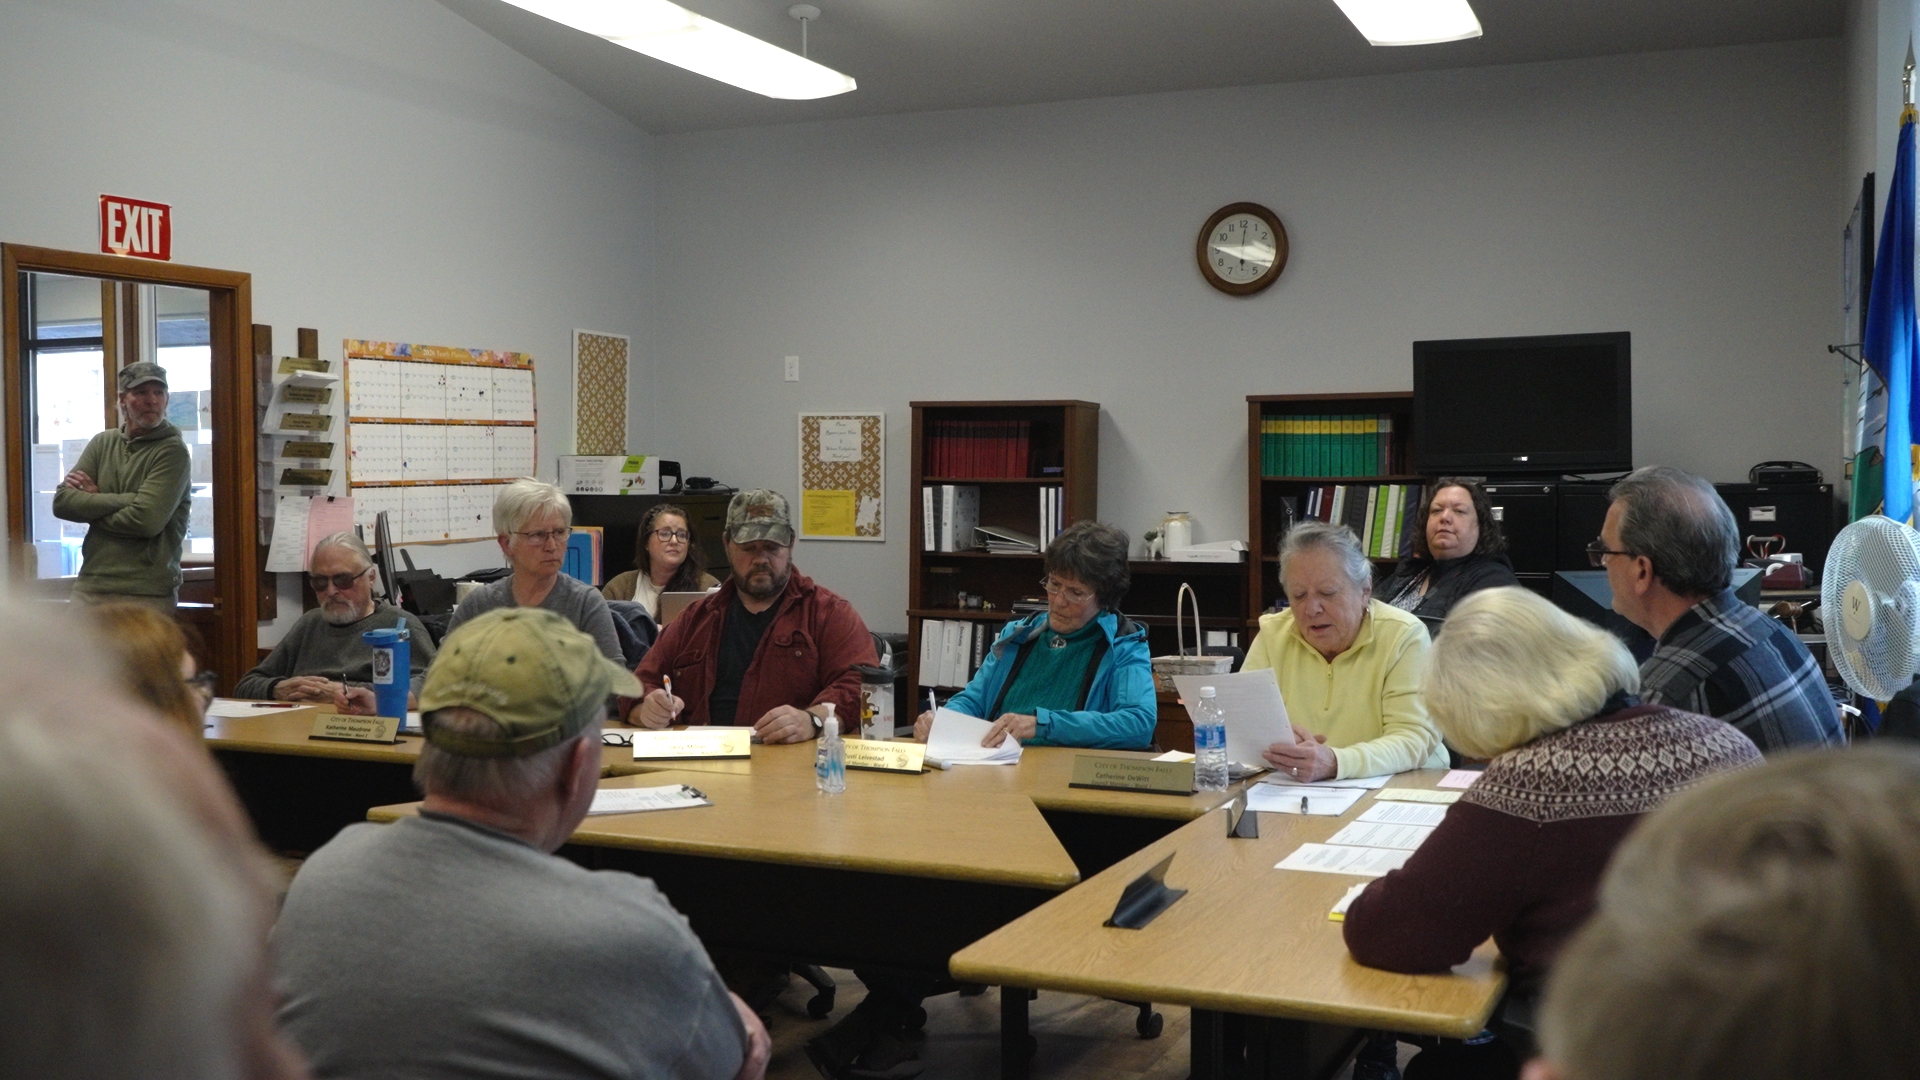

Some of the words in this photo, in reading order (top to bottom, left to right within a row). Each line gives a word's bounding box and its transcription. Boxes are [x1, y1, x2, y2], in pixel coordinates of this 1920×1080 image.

[108, 201, 164, 254] EXIT
[1228, 224, 1234, 232] 11
[1240, 220, 1248, 228] 12
[1220, 233, 1228, 241] 10
[1262, 232, 1268, 240] 2
[1266, 244, 1271, 253] 3
[1218, 258, 1224, 266] 8
[1228, 267, 1233, 275] 7
[1252, 266, 1258, 275] 5
[436, 350, 450, 358] Yearly
[1120, 764, 1154, 772] THOMPSON
